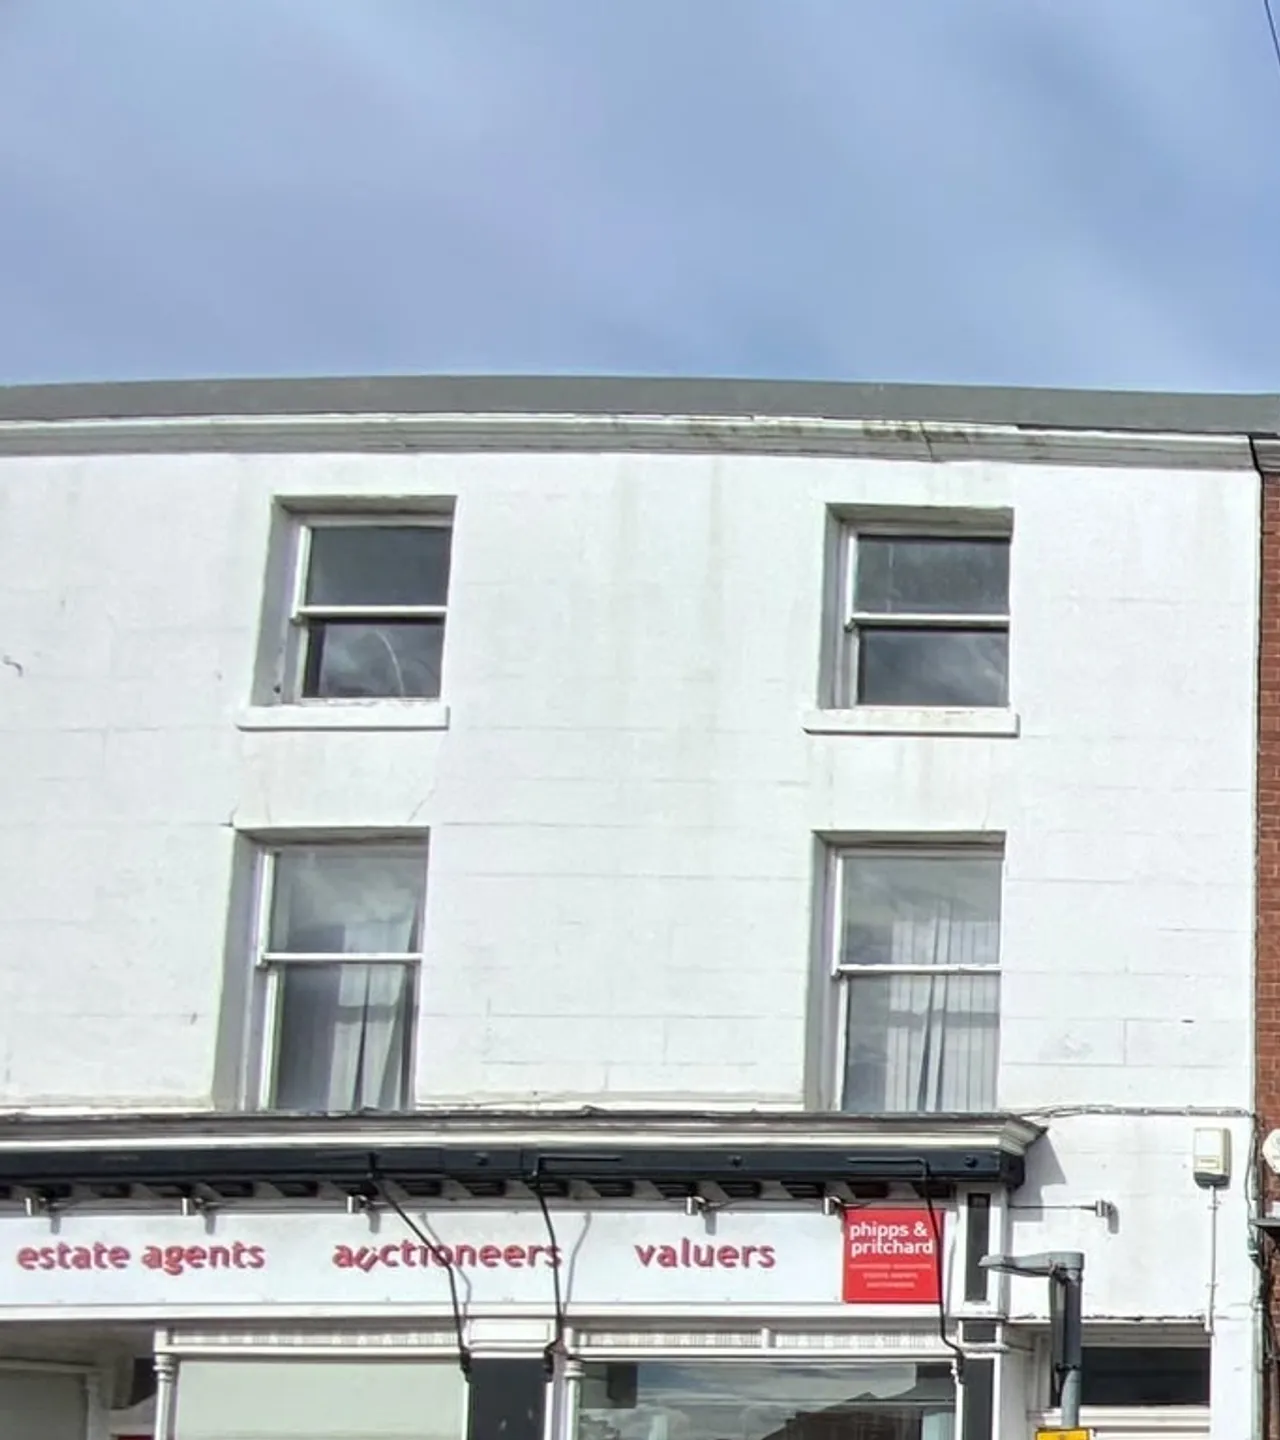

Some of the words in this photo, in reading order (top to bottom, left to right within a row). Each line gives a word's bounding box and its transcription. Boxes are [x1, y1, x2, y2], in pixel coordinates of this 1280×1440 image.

[850, 1221, 909, 1240] phipps
[913, 1221, 928, 1237] &
[17, 1241, 130, 1269] estate
[141, 1241, 266, 1275] agents
[332, 1239, 562, 1272] auctioneers
[634, 1238, 776, 1268] valuers
[851, 1239, 933, 1258] pritchard
